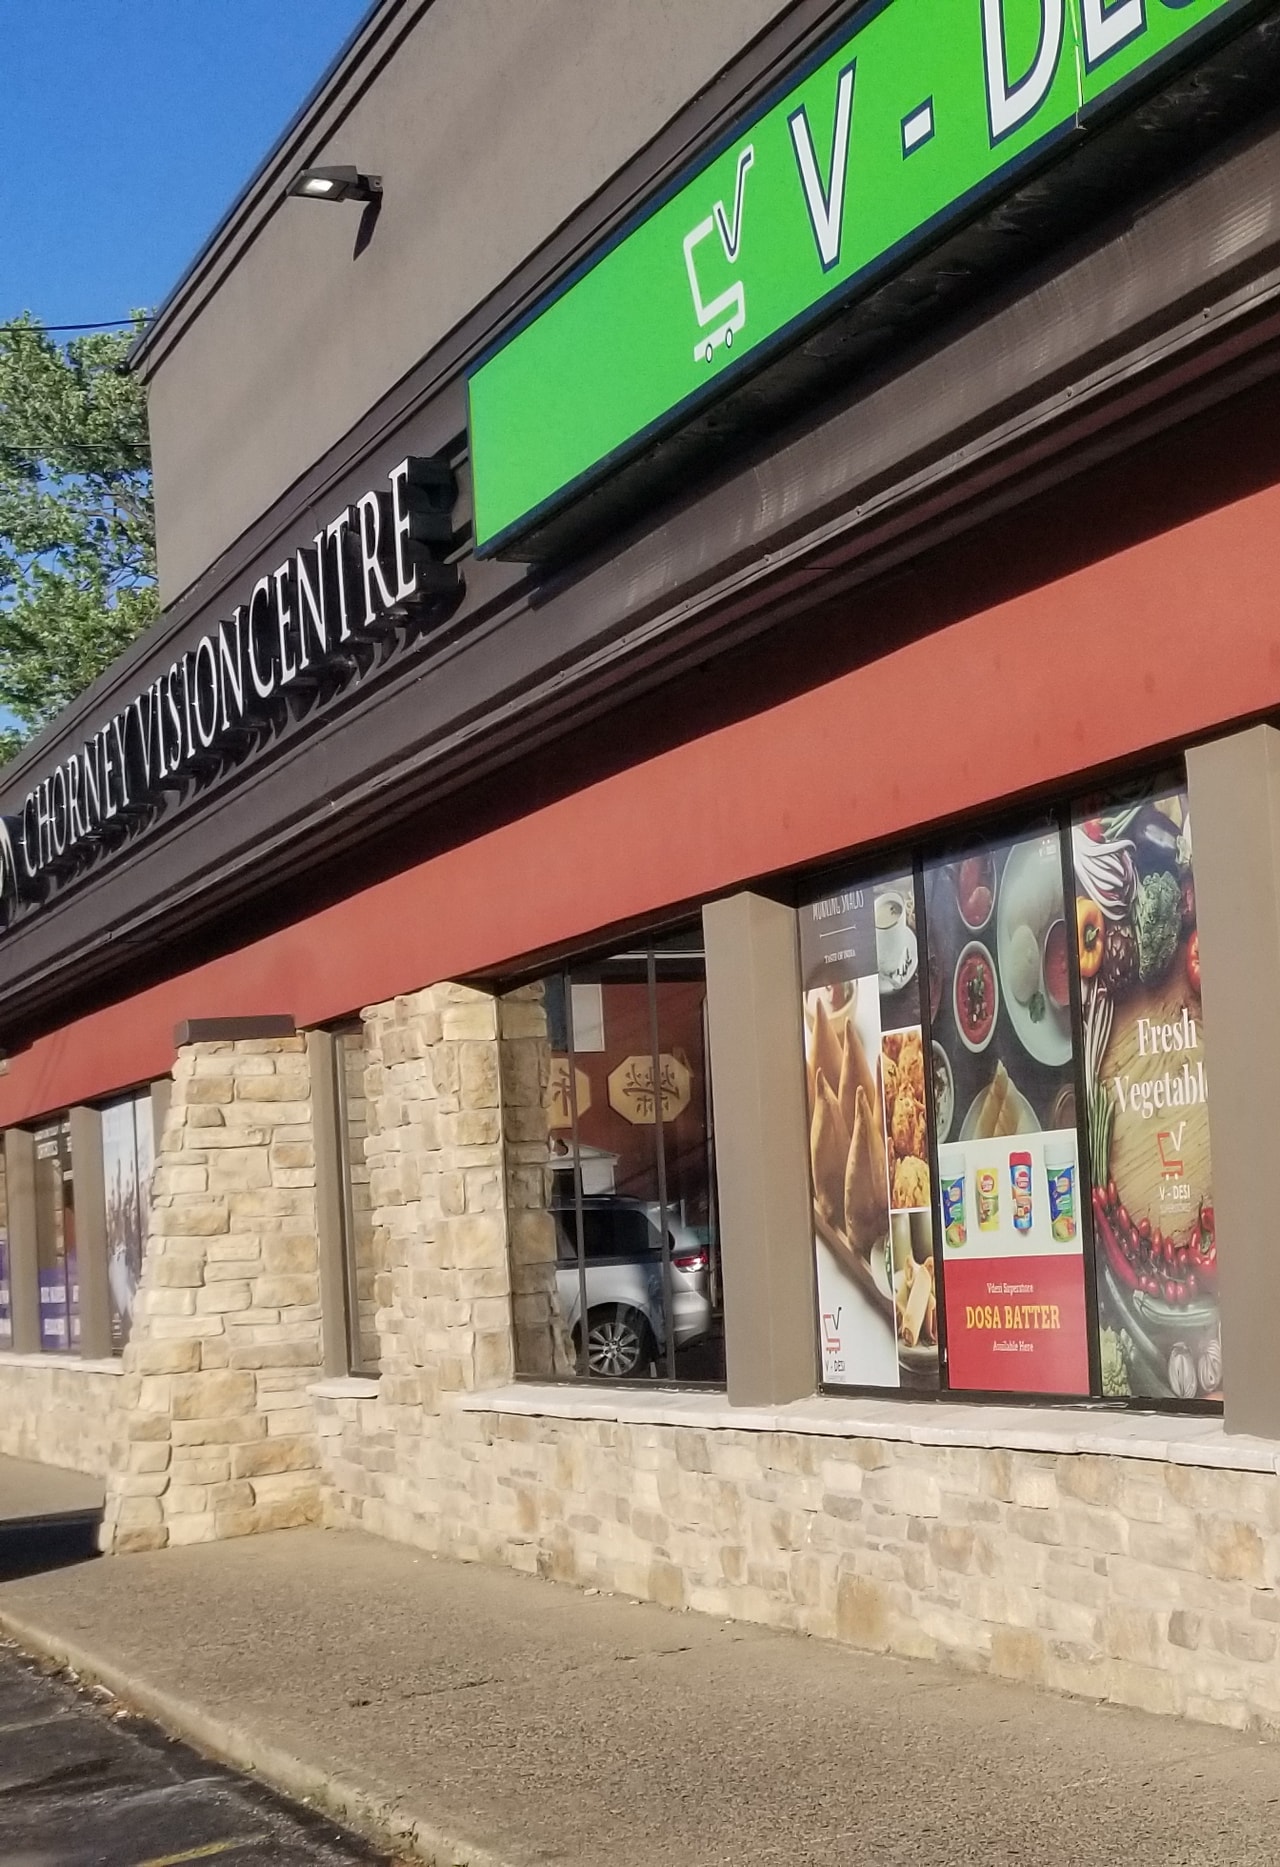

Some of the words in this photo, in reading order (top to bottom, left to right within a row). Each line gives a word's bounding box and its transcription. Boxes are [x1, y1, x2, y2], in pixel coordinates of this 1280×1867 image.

[788, 57, 857, 273] V
[23, 706, 132, 878] CHORNEY
[134, 606, 247, 786] VISION
[248, 458, 418, 699] CENTRE
[1136, 1007, 1199, 1057] Fresh
[1159, 1185, 1168, 1201] V
[1172, 1184, 1191, 1201] DESI
[966, 1305, 1002, 1329] DOSA
[1003, 1305, 1061, 1329] BATTER
